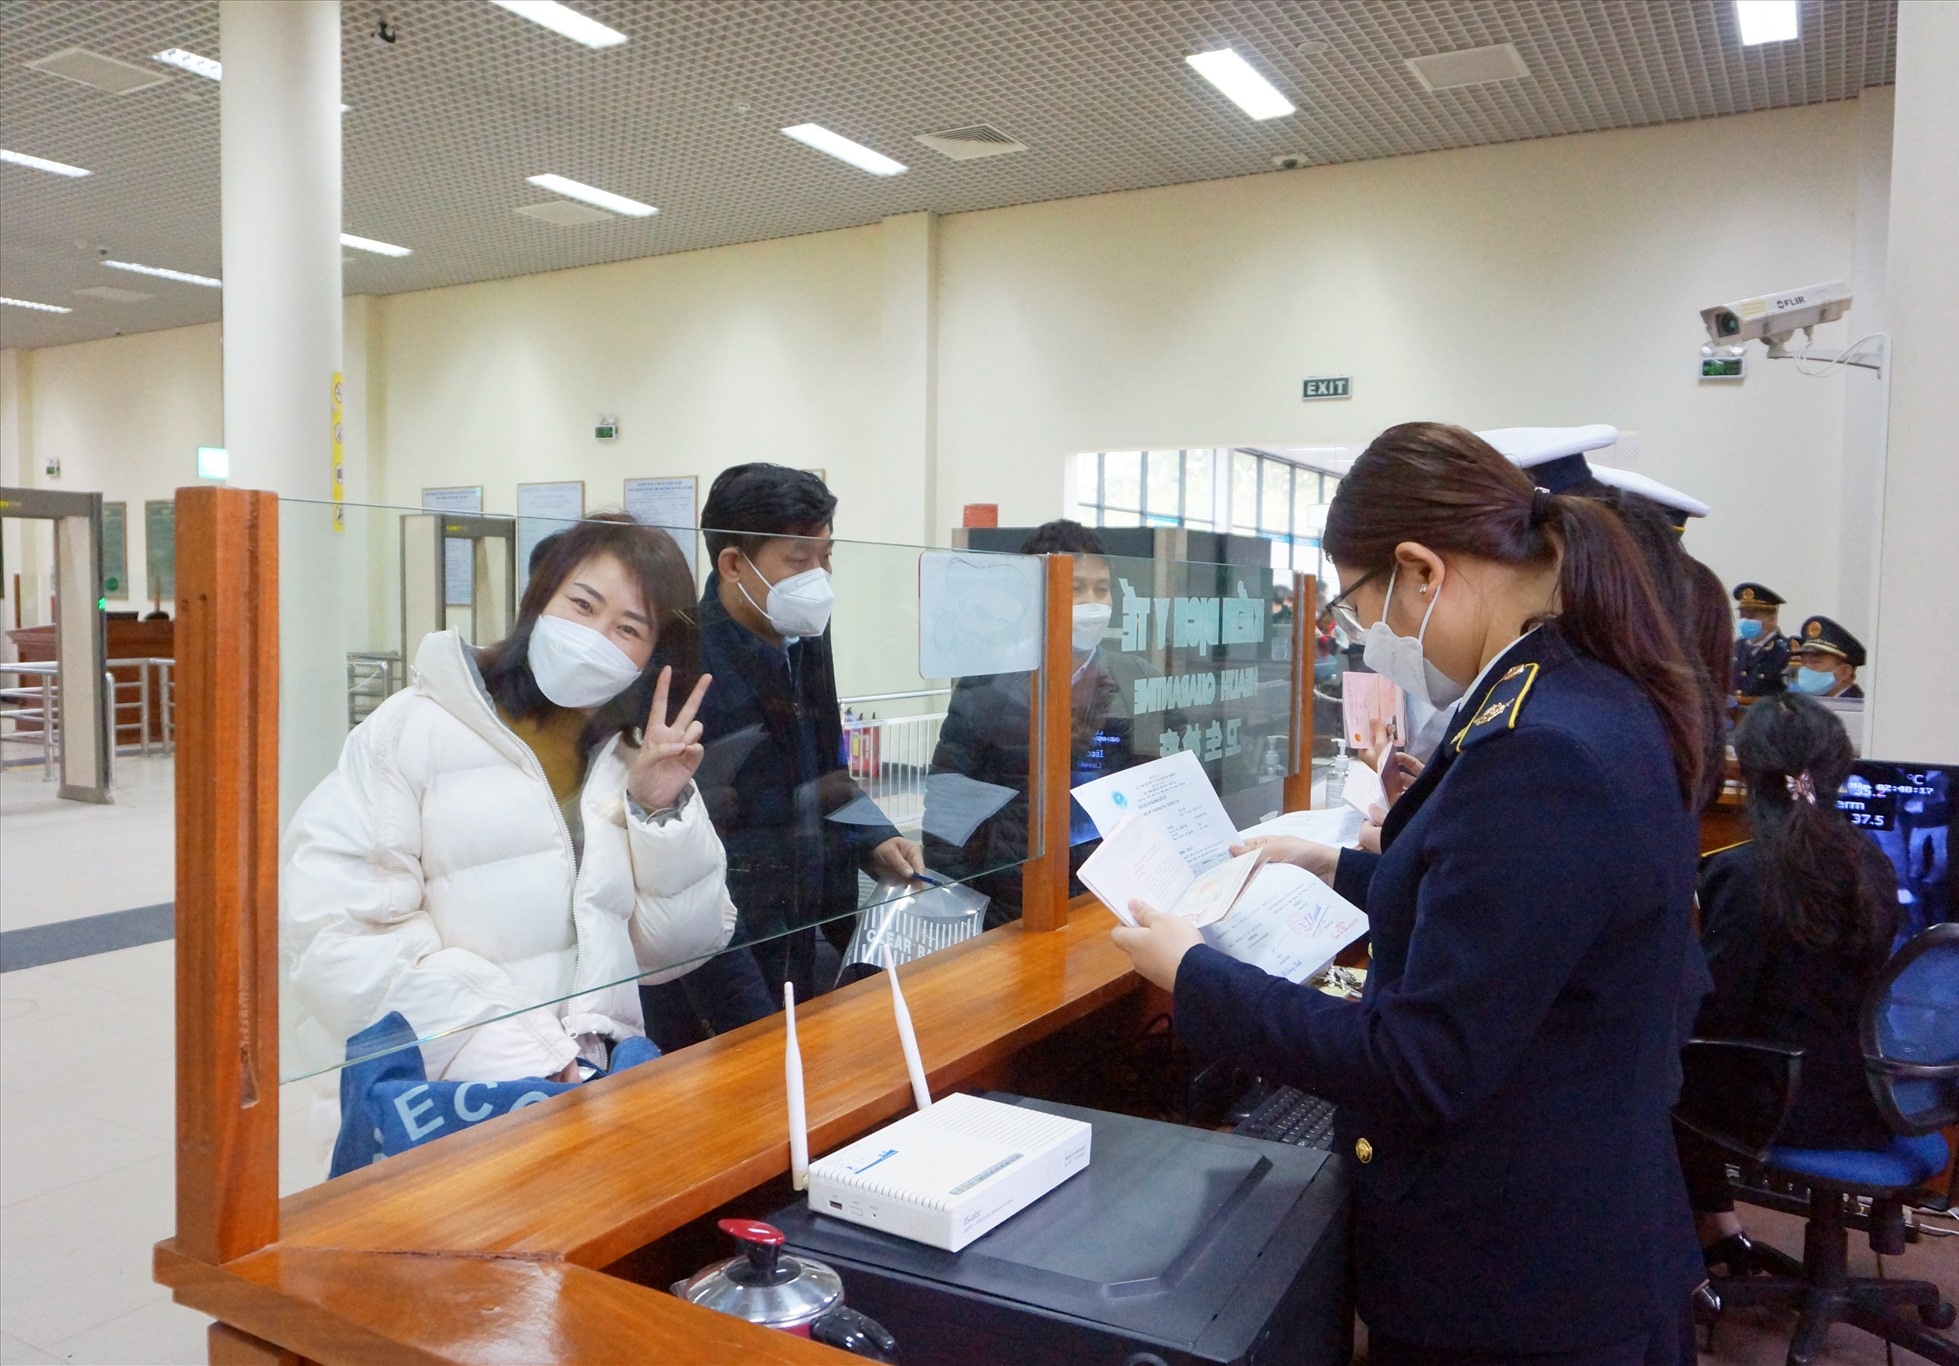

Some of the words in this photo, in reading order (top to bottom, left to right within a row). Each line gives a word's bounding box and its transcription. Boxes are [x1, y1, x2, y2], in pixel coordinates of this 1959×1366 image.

[1784, 295, 1806, 307] FLIR
[1306, 380, 1346, 395] EXIT
[1851, 812, 1884, 826] 37.5
